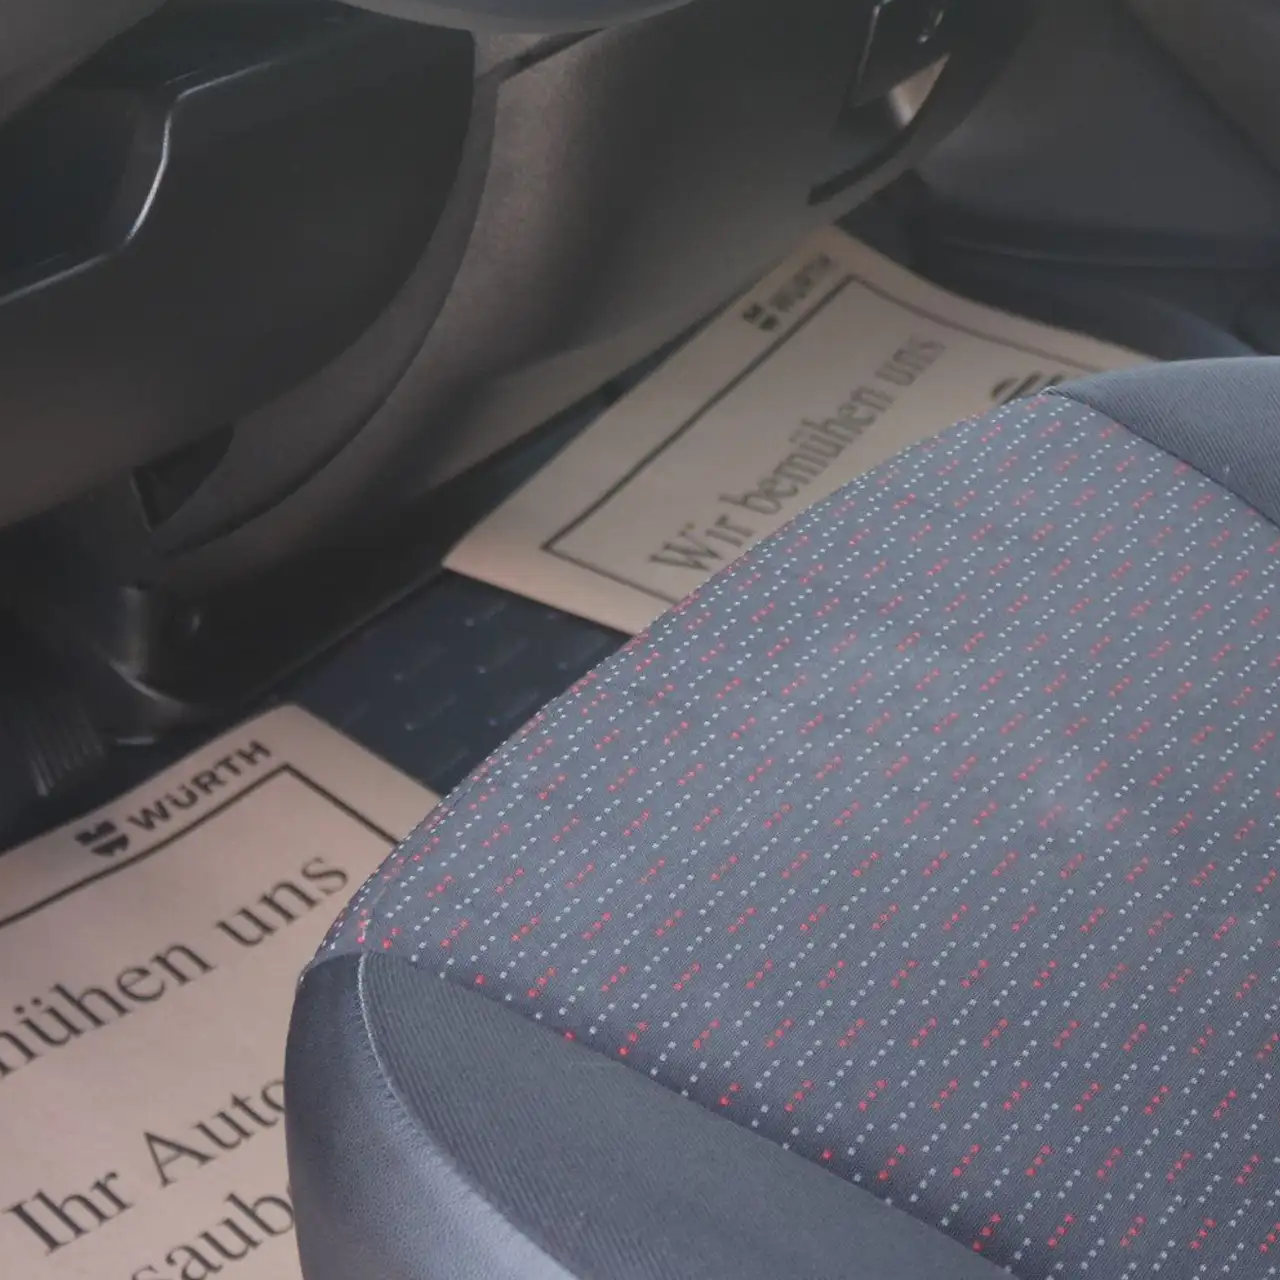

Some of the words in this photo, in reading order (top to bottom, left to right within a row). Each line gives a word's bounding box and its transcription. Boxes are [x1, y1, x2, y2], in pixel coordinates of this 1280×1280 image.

[647, 515, 756, 572] Wir
[718, 385, 896, 516] bemühen
[875, 335, 947, 387] uns
[126, 740, 272, 831] WÜRTH
[215, 857, 349, 948] uns
[1, 1170, 135, 1257] Ihr
